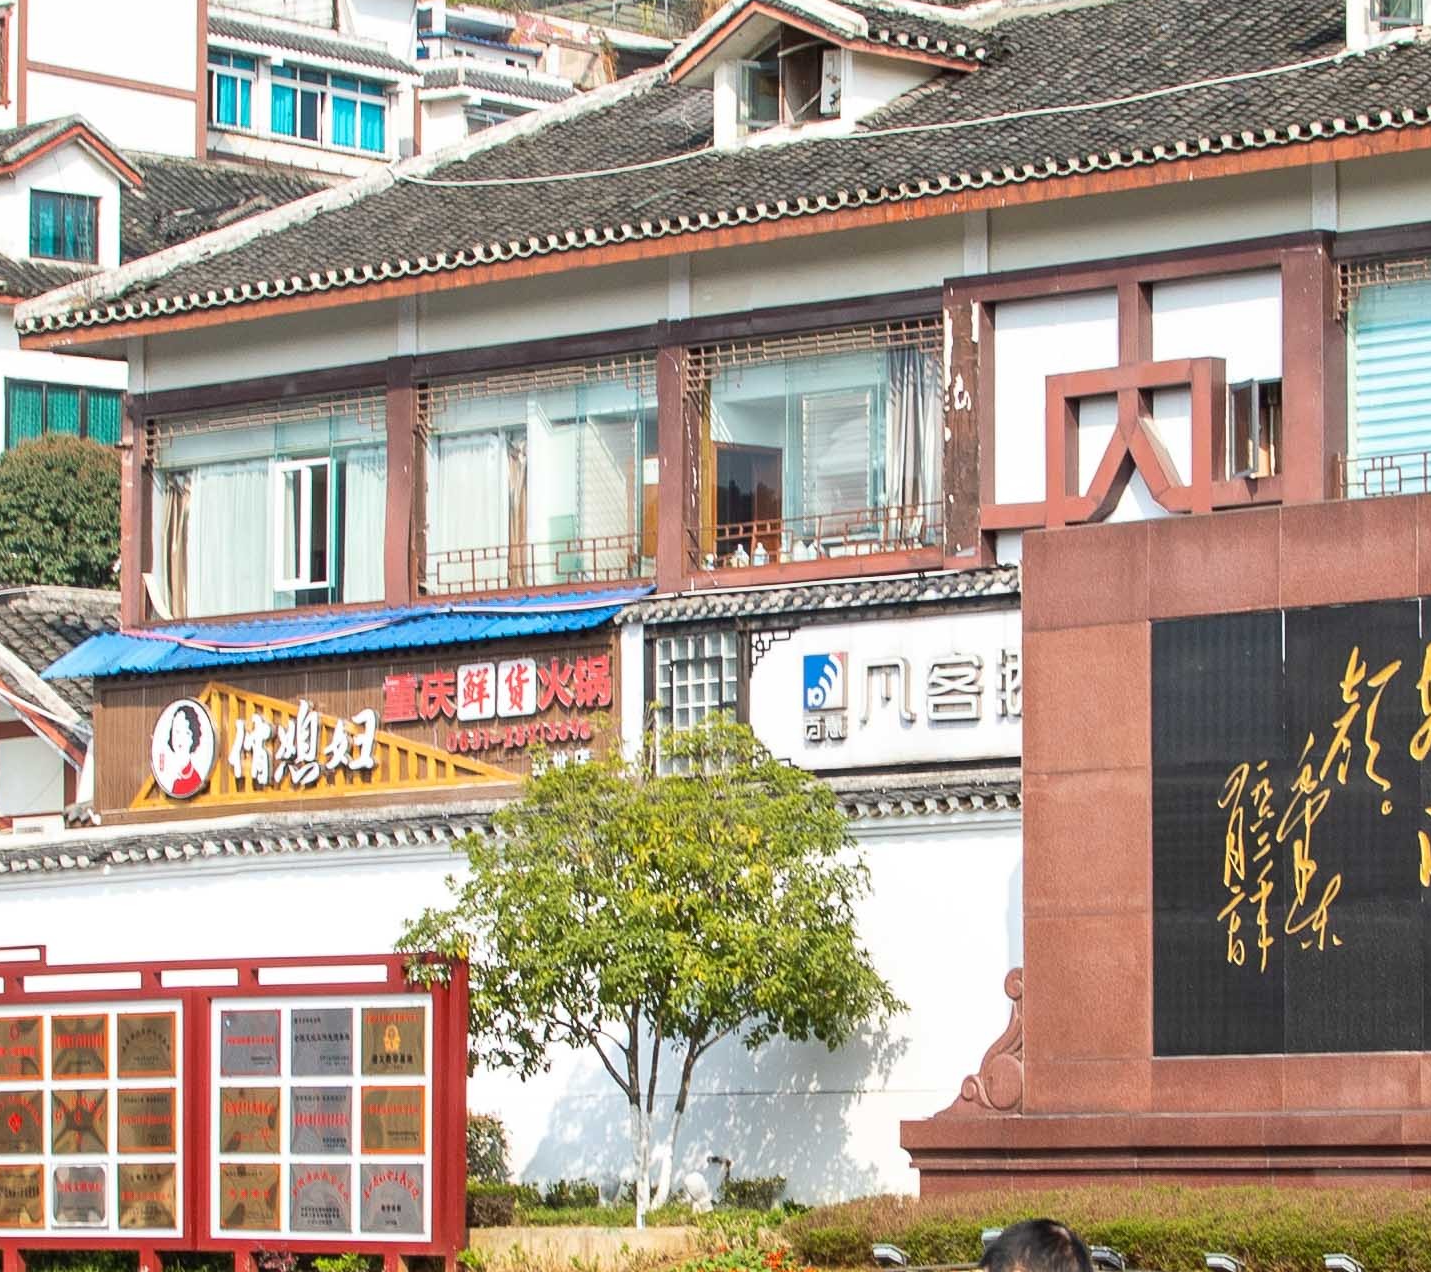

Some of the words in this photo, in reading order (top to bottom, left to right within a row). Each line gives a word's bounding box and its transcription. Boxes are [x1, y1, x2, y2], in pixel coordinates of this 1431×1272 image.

[383, 655, 613, 723] 重庆鲜货火锅
[228, 700, 378, 786] 俏媳妇
